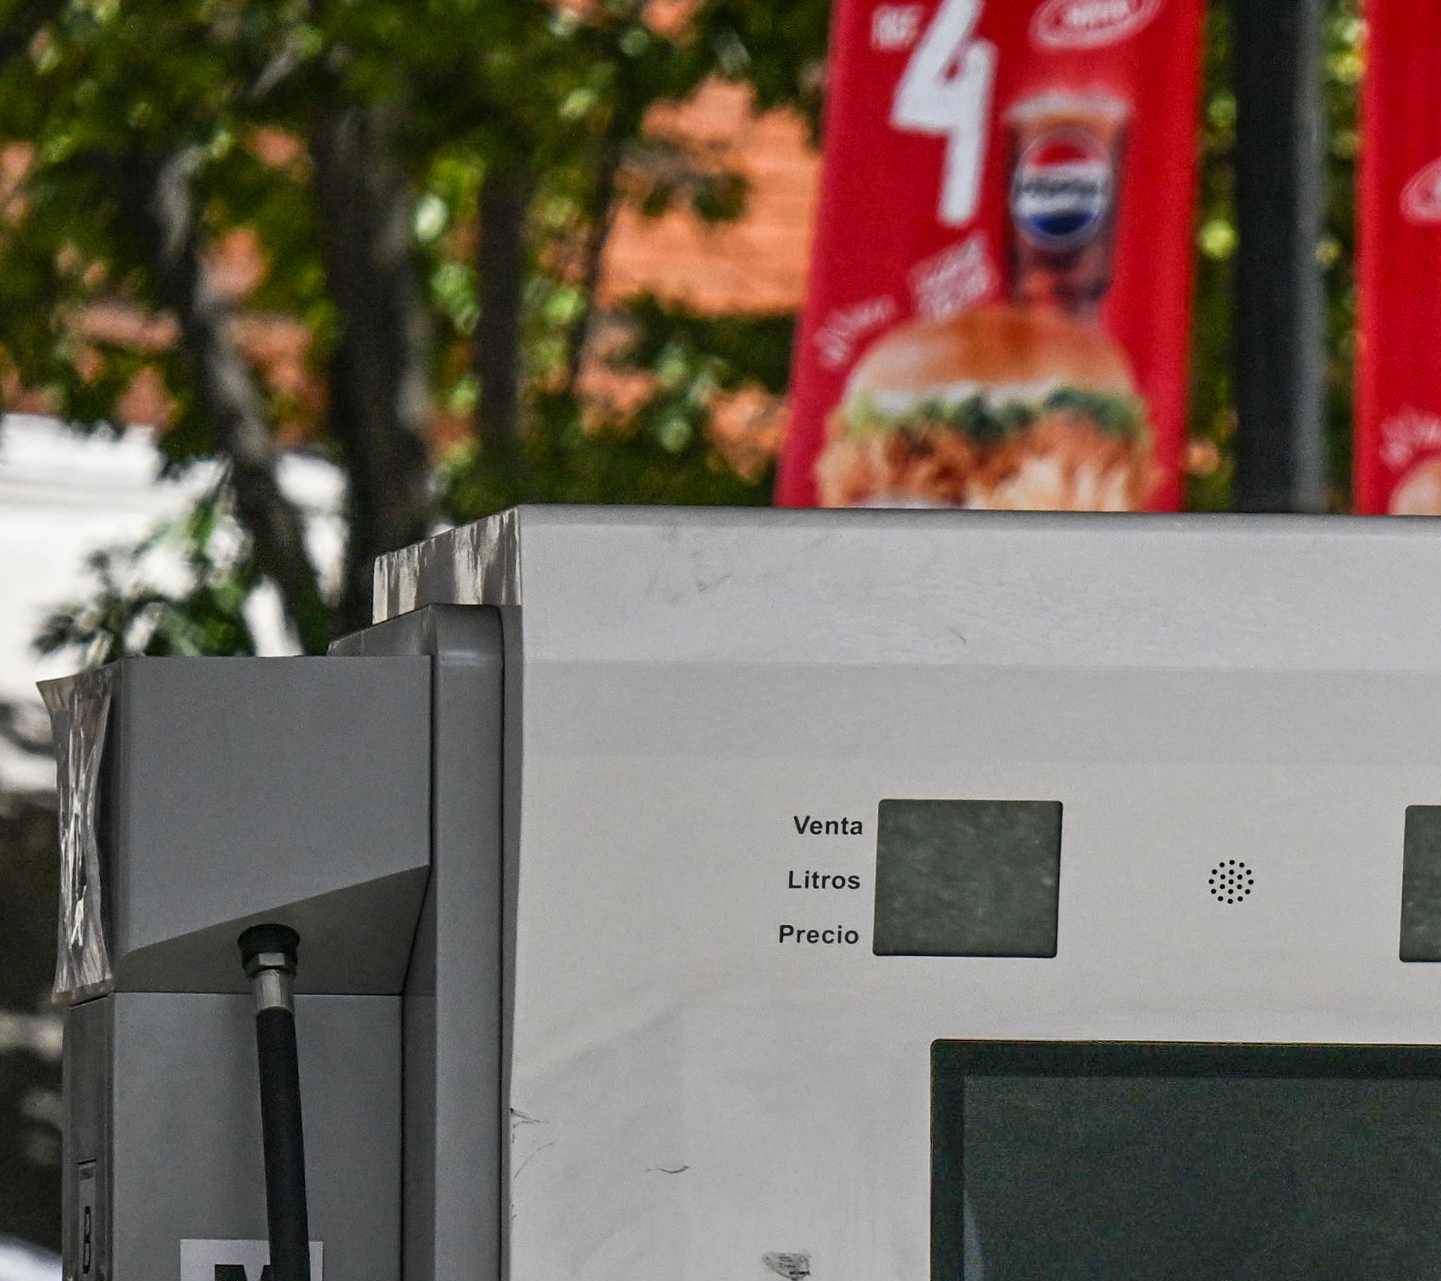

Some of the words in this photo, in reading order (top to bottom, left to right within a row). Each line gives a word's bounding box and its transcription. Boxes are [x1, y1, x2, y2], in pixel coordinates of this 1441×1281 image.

[890, 0, 998, 228] 4
[793, 815, 863, 836] Venta
[788, 870, 861, 890] Litros
[779, 924, 859, 945] Precio
